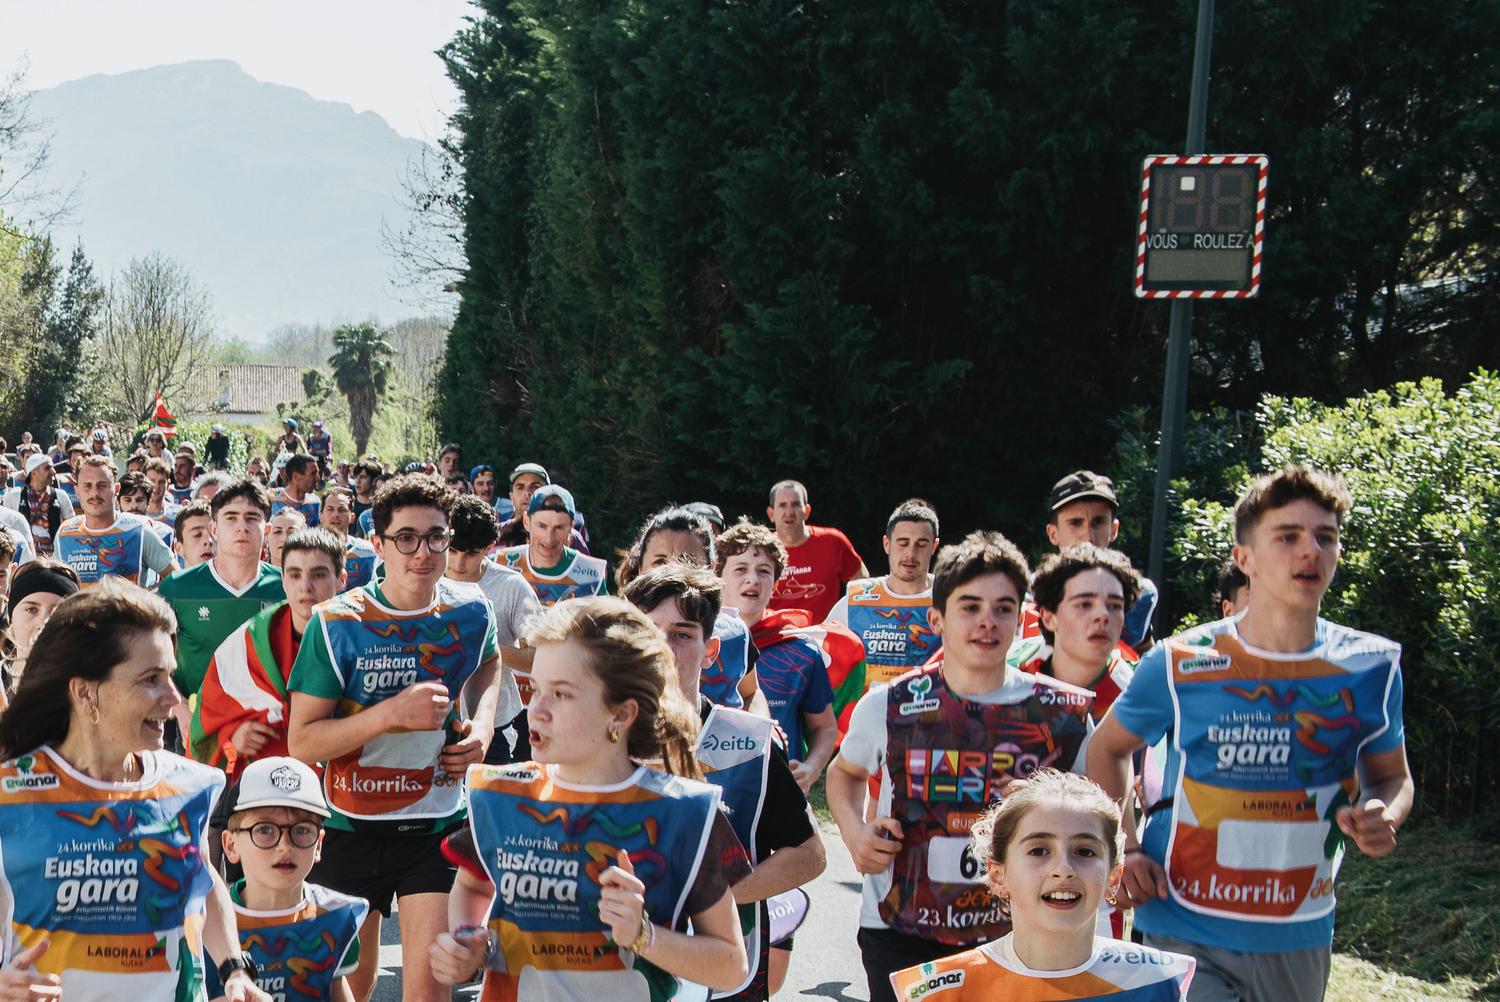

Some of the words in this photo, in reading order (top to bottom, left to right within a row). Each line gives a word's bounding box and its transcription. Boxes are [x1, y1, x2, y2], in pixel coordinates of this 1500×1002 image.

[1146, 234, 1178, 249] VOUS
[1194, 234, 1243, 249] ROULEZ
[67, 553, 98, 563] Euskara
[862, 629, 908, 641] Euskara
[364, 644, 402, 655] 24.korrika
[867, 639, 907, 655] gara
[356, 655, 416, 670] Euskara
[363, 670, 417, 693] gara
[1058, 692, 1087, 706] eitb
[1219, 709, 1271, 724] 24.korrika
[1207, 723, 1291, 744] Euskara
[720, 735, 756, 751] eitb
[1216, 743, 1291, 770] gara
[332, 772, 423, 792] 24.korrika
[1243, 800, 1293, 812] LABORAL
[56, 838, 115, 854] 24.korrika
[504, 834, 559, 852] 24.korrika
[44, 853, 138, 879] Euskara
[497, 847, 580, 878] Euskara
[960, 844, 980, 879] 6
[56, 877, 139, 914] gara
[500, 871, 579, 906] gara
[1176, 874, 1296, 905] 24.korrika
[1310, 877, 1334, 900] ae
[87, 945, 144, 960] LABORAL
[532, 944, 591, 957] LABORAL
[1125, 948, 1175, 966] eitb
[266, 961, 284, 972] aek
[256, 976, 286, 992] ara
[910, 973, 962, 999] goiener
